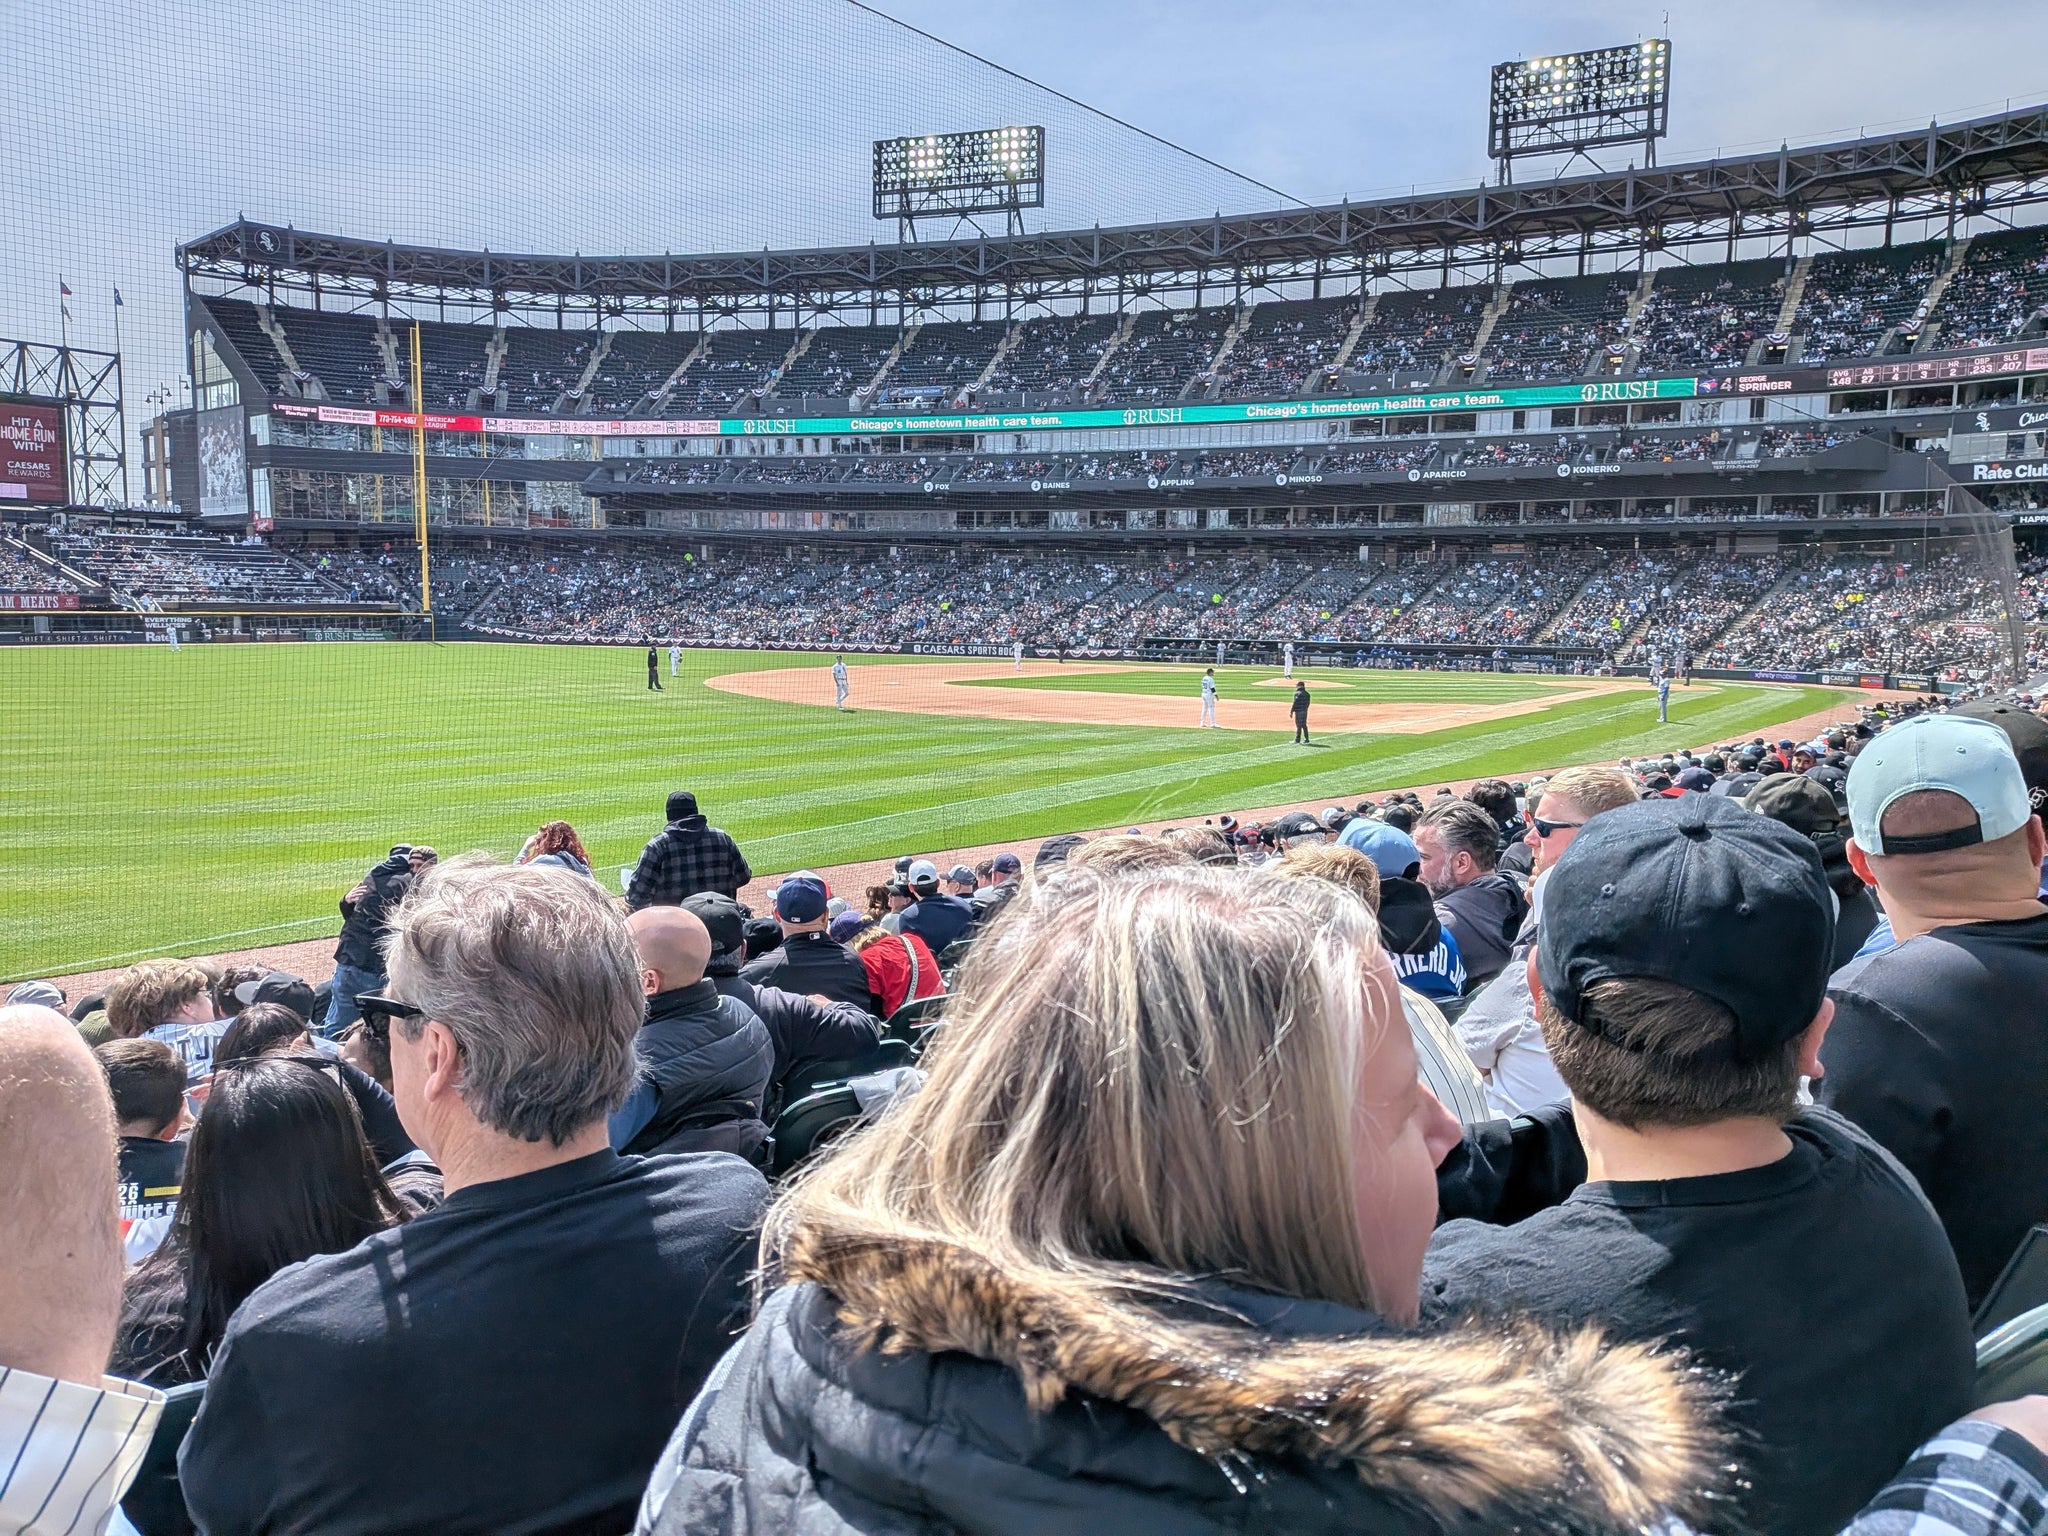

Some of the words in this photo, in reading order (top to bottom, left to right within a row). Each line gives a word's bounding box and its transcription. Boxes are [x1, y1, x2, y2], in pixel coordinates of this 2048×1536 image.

[1970, 365, 1992, 374] .233
[1999, 362, 2022, 371] .407
[1720, 378, 1733, 392] 4
[1738, 381, 1792, 392] SPRINGER
[1829, 378, 1851, 386] .148
[1601, 380, 1658, 400] RUSH
[1246, 404, 1307, 418] Chicago's
[1312, 400, 1380, 414] hometown
[1384, 398, 1426, 410] health
[1430, 396, 1460, 407] care
[1464, 394, 1504, 405] team.
[1139, 408, 1182, 424] RUSH
[12, 416, 31, 427] HIT
[34, 419, 43, 428] A
[758, 420, 796, 434] RUSH
[850, 420, 902, 432] Chicago's
[906, 418, 962, 429] hometown
[965, 416, 999, 427] health
[1002, 417, 1027, 426] care
[1030, 416, 1062, 426] team.
[0, 426, 32, 441] HOME
[34, 428, 55, 443] RUN
[13, 441, 44, 452] WITH
[7, 461, 50, 470] CAESARS
[1559, 466, 1568, 474] 14
[1572, 464, 1620, 474] KONERKO
[8, 469, 52, 478] REWARDS
[1422, 470, 1466, 479] APARICIO
[1974, 464, 2012, 480] Rate
[2015, 464, 2048, 478] Club
[1160, 478, 1194, 486] APPLING
[20, 596, 59, 608] MEATS
[324, 632, 350, 640] RUSH
[922, 645, 966, 654] CAESARS
[1754, 672, 1776, 680] xfinity
[118, 1182, 140, 1200] 26
